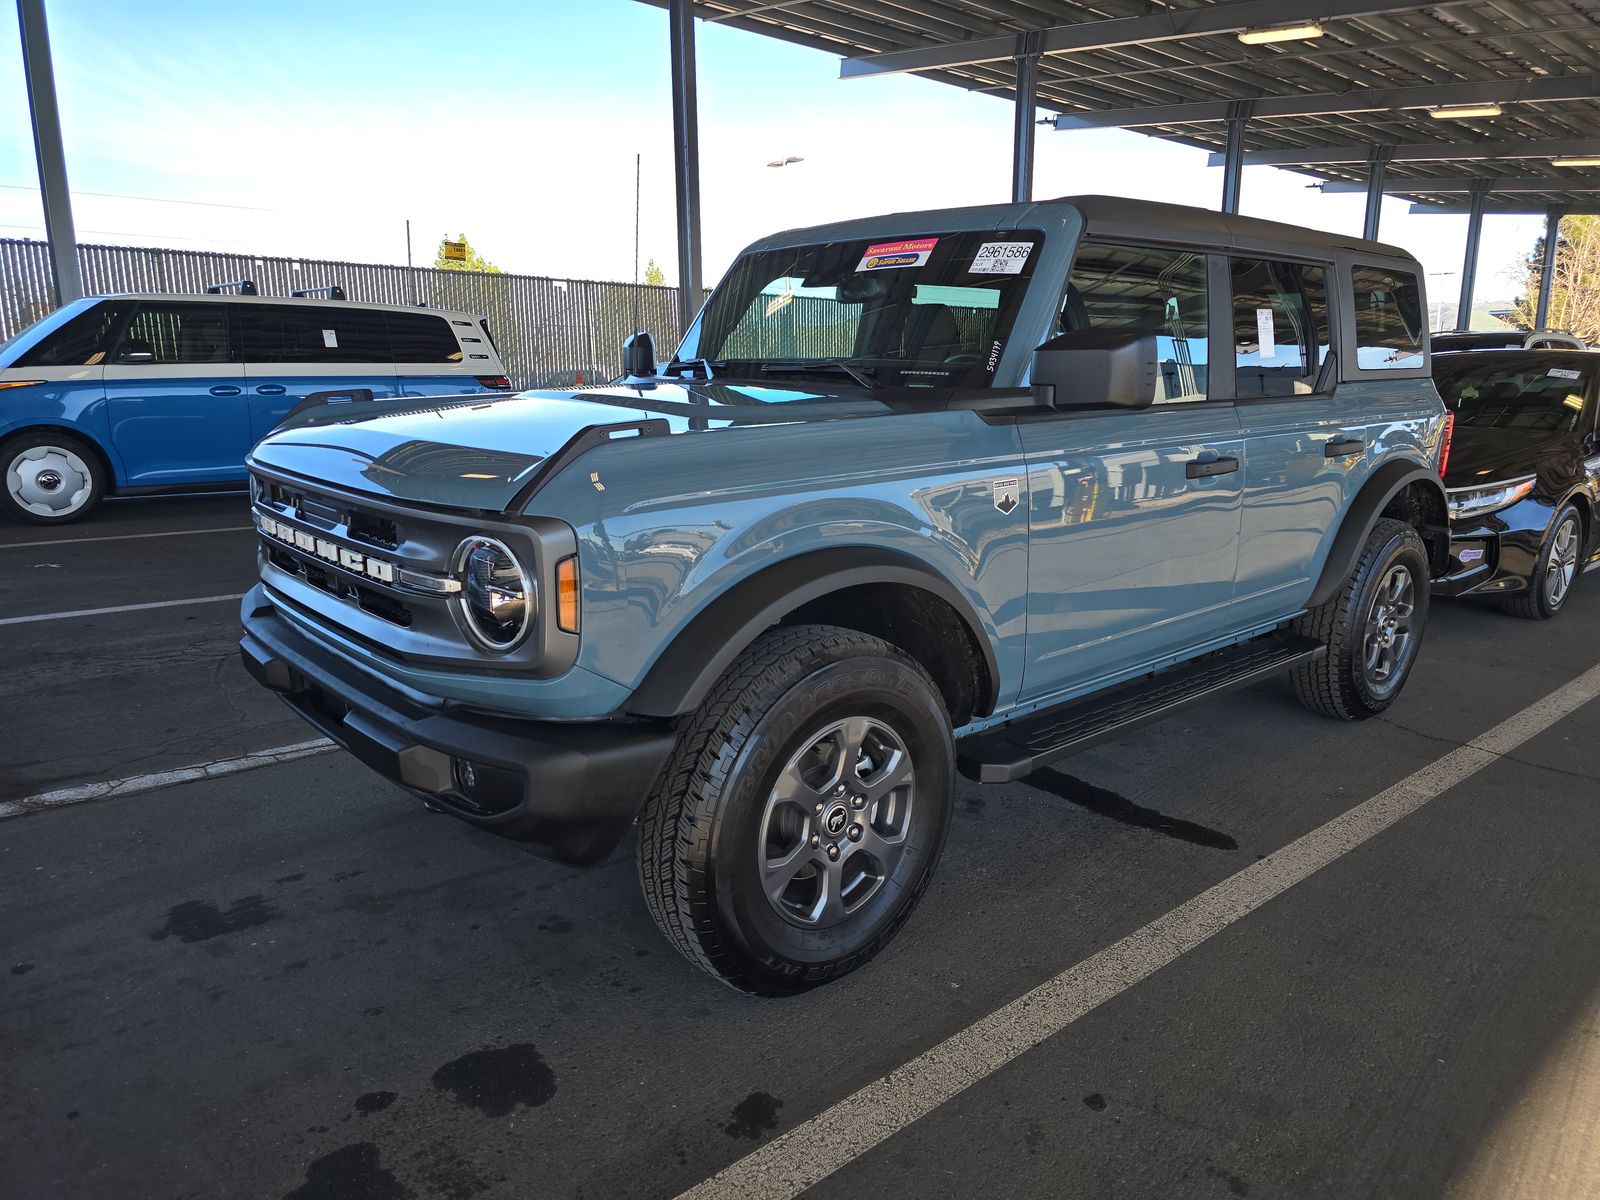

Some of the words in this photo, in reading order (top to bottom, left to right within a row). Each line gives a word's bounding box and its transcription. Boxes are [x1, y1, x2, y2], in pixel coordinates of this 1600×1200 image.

[867, 244, 902, 255] Savarani
[903, 242, 934, 251] Motors
[978, 246, 1031, 258] 2961586
[260, 514, 393, 583] BRONCO
